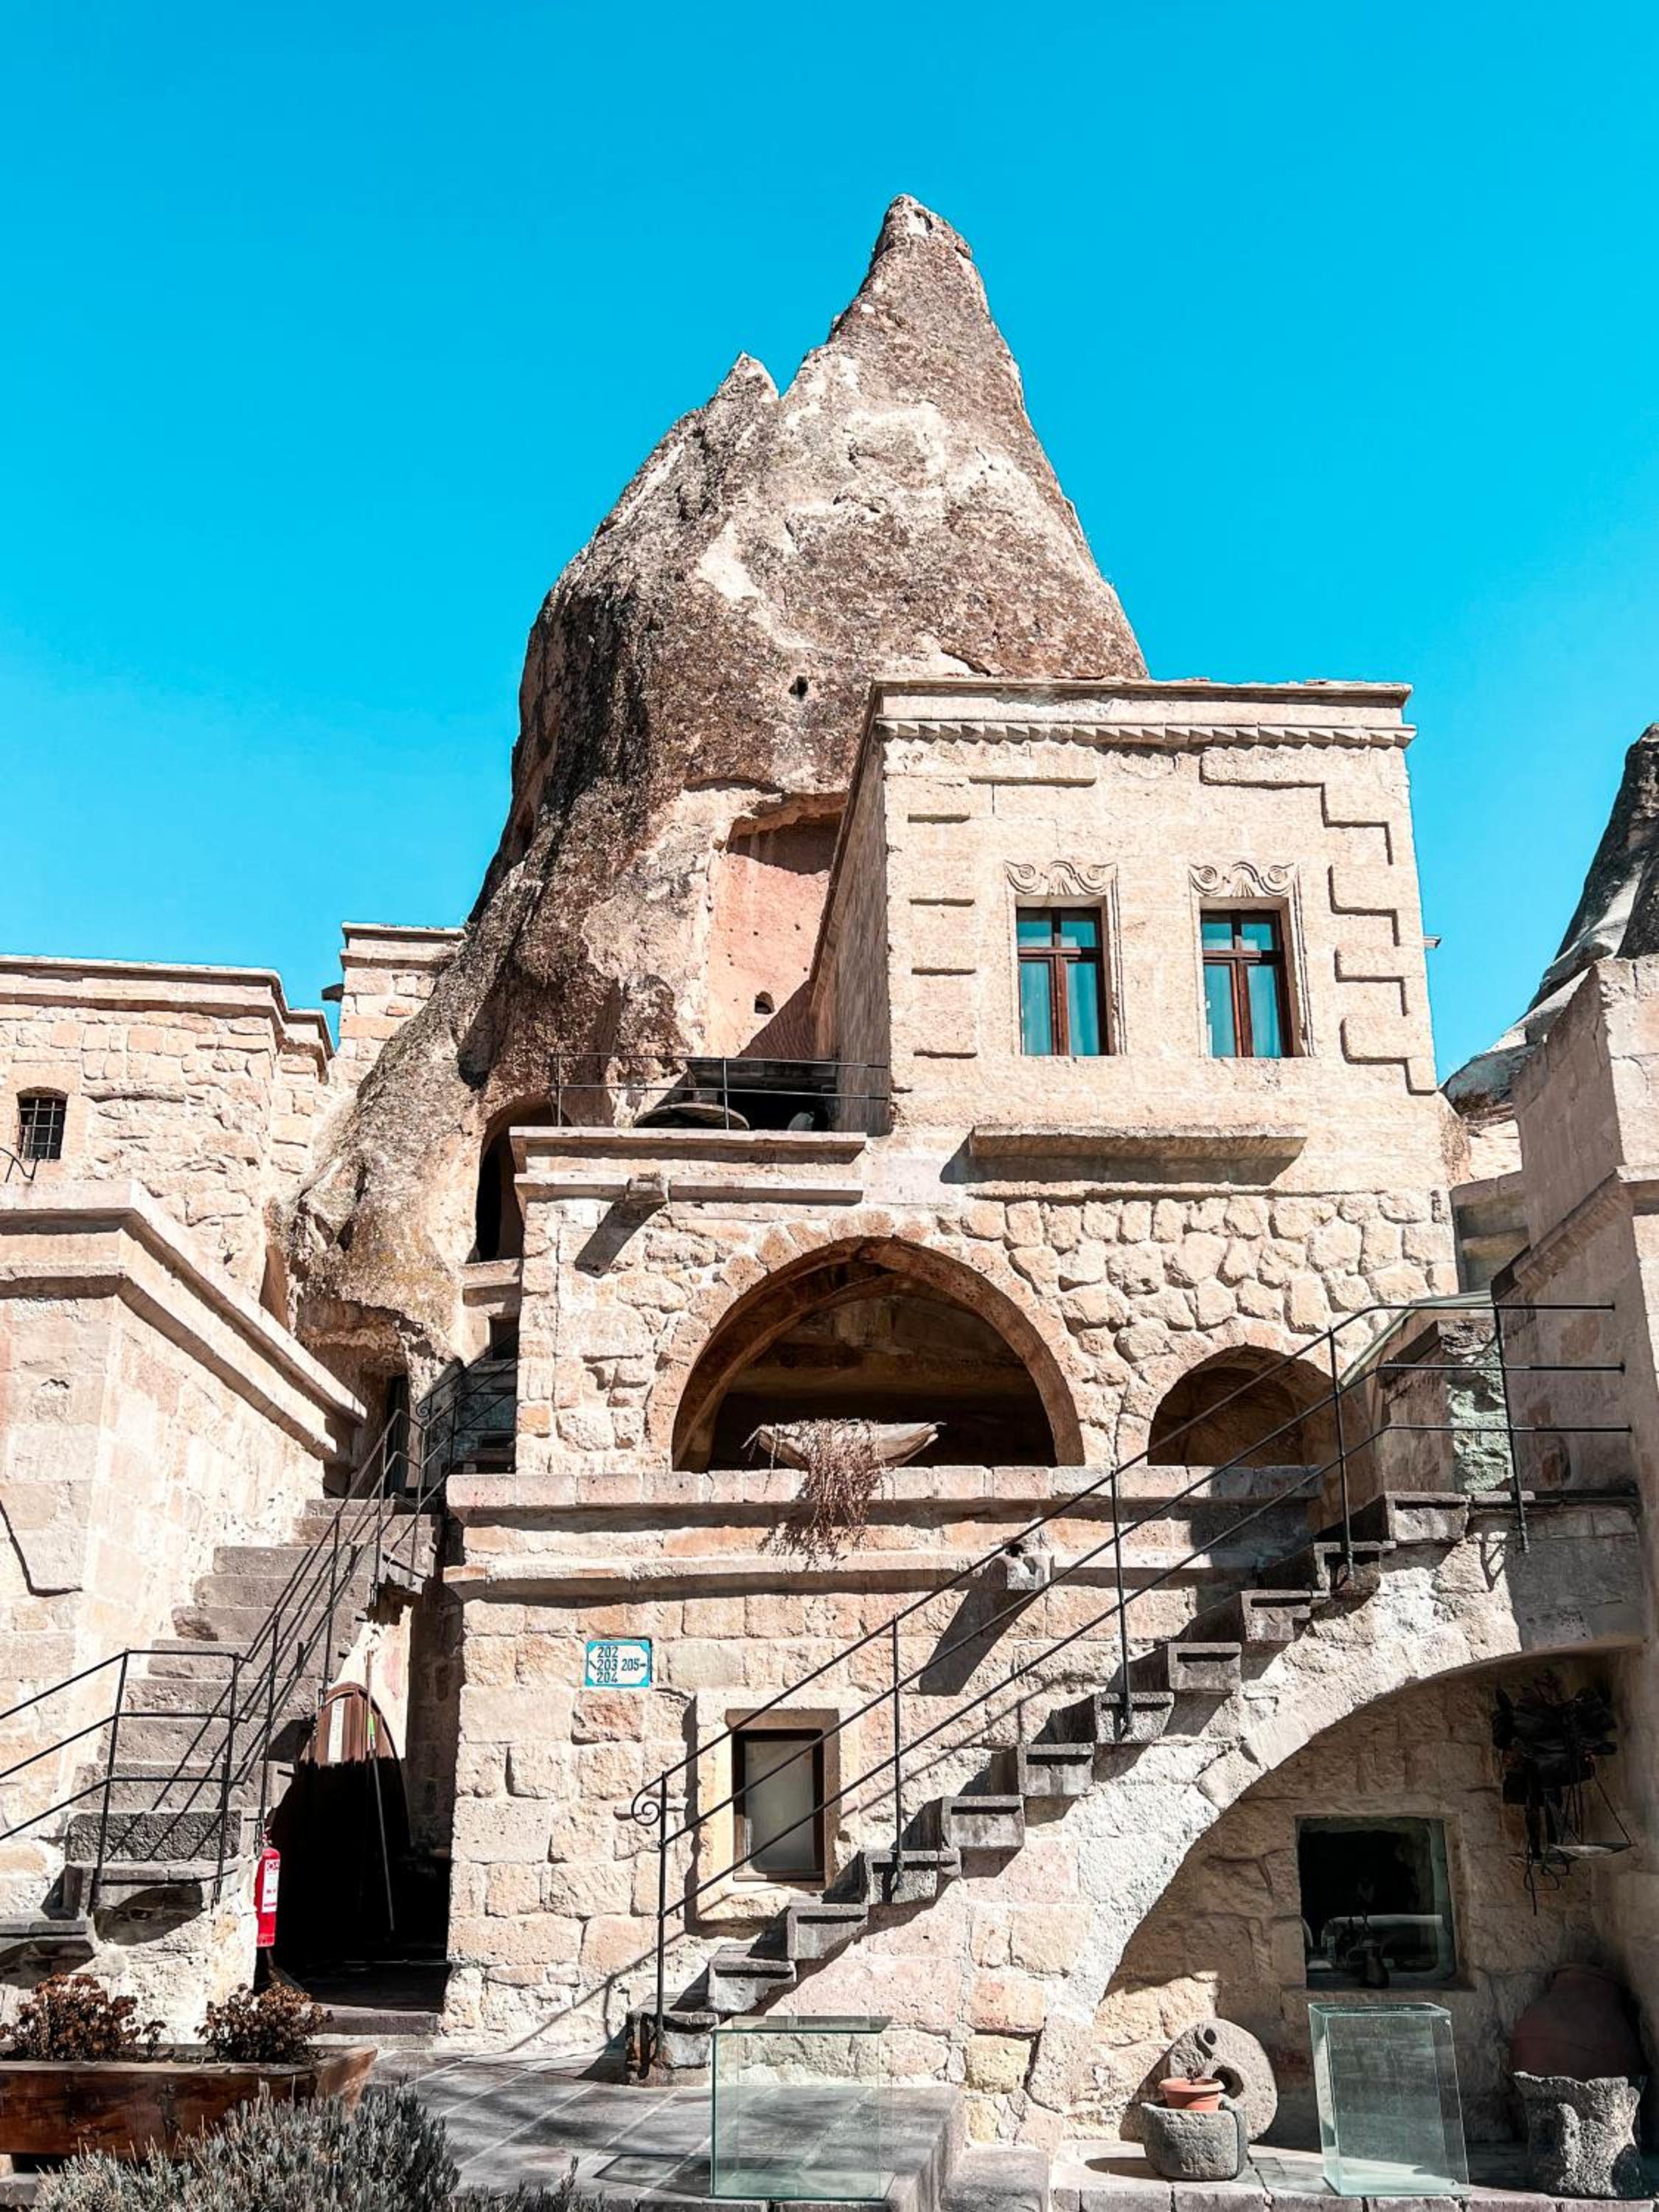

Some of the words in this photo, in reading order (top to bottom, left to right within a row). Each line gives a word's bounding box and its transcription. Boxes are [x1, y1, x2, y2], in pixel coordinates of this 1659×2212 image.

[597, 1646, 618, 1658] 202
[597, 1659, 618, 1671] 203
[597, 1672, 618, 1683] 204
